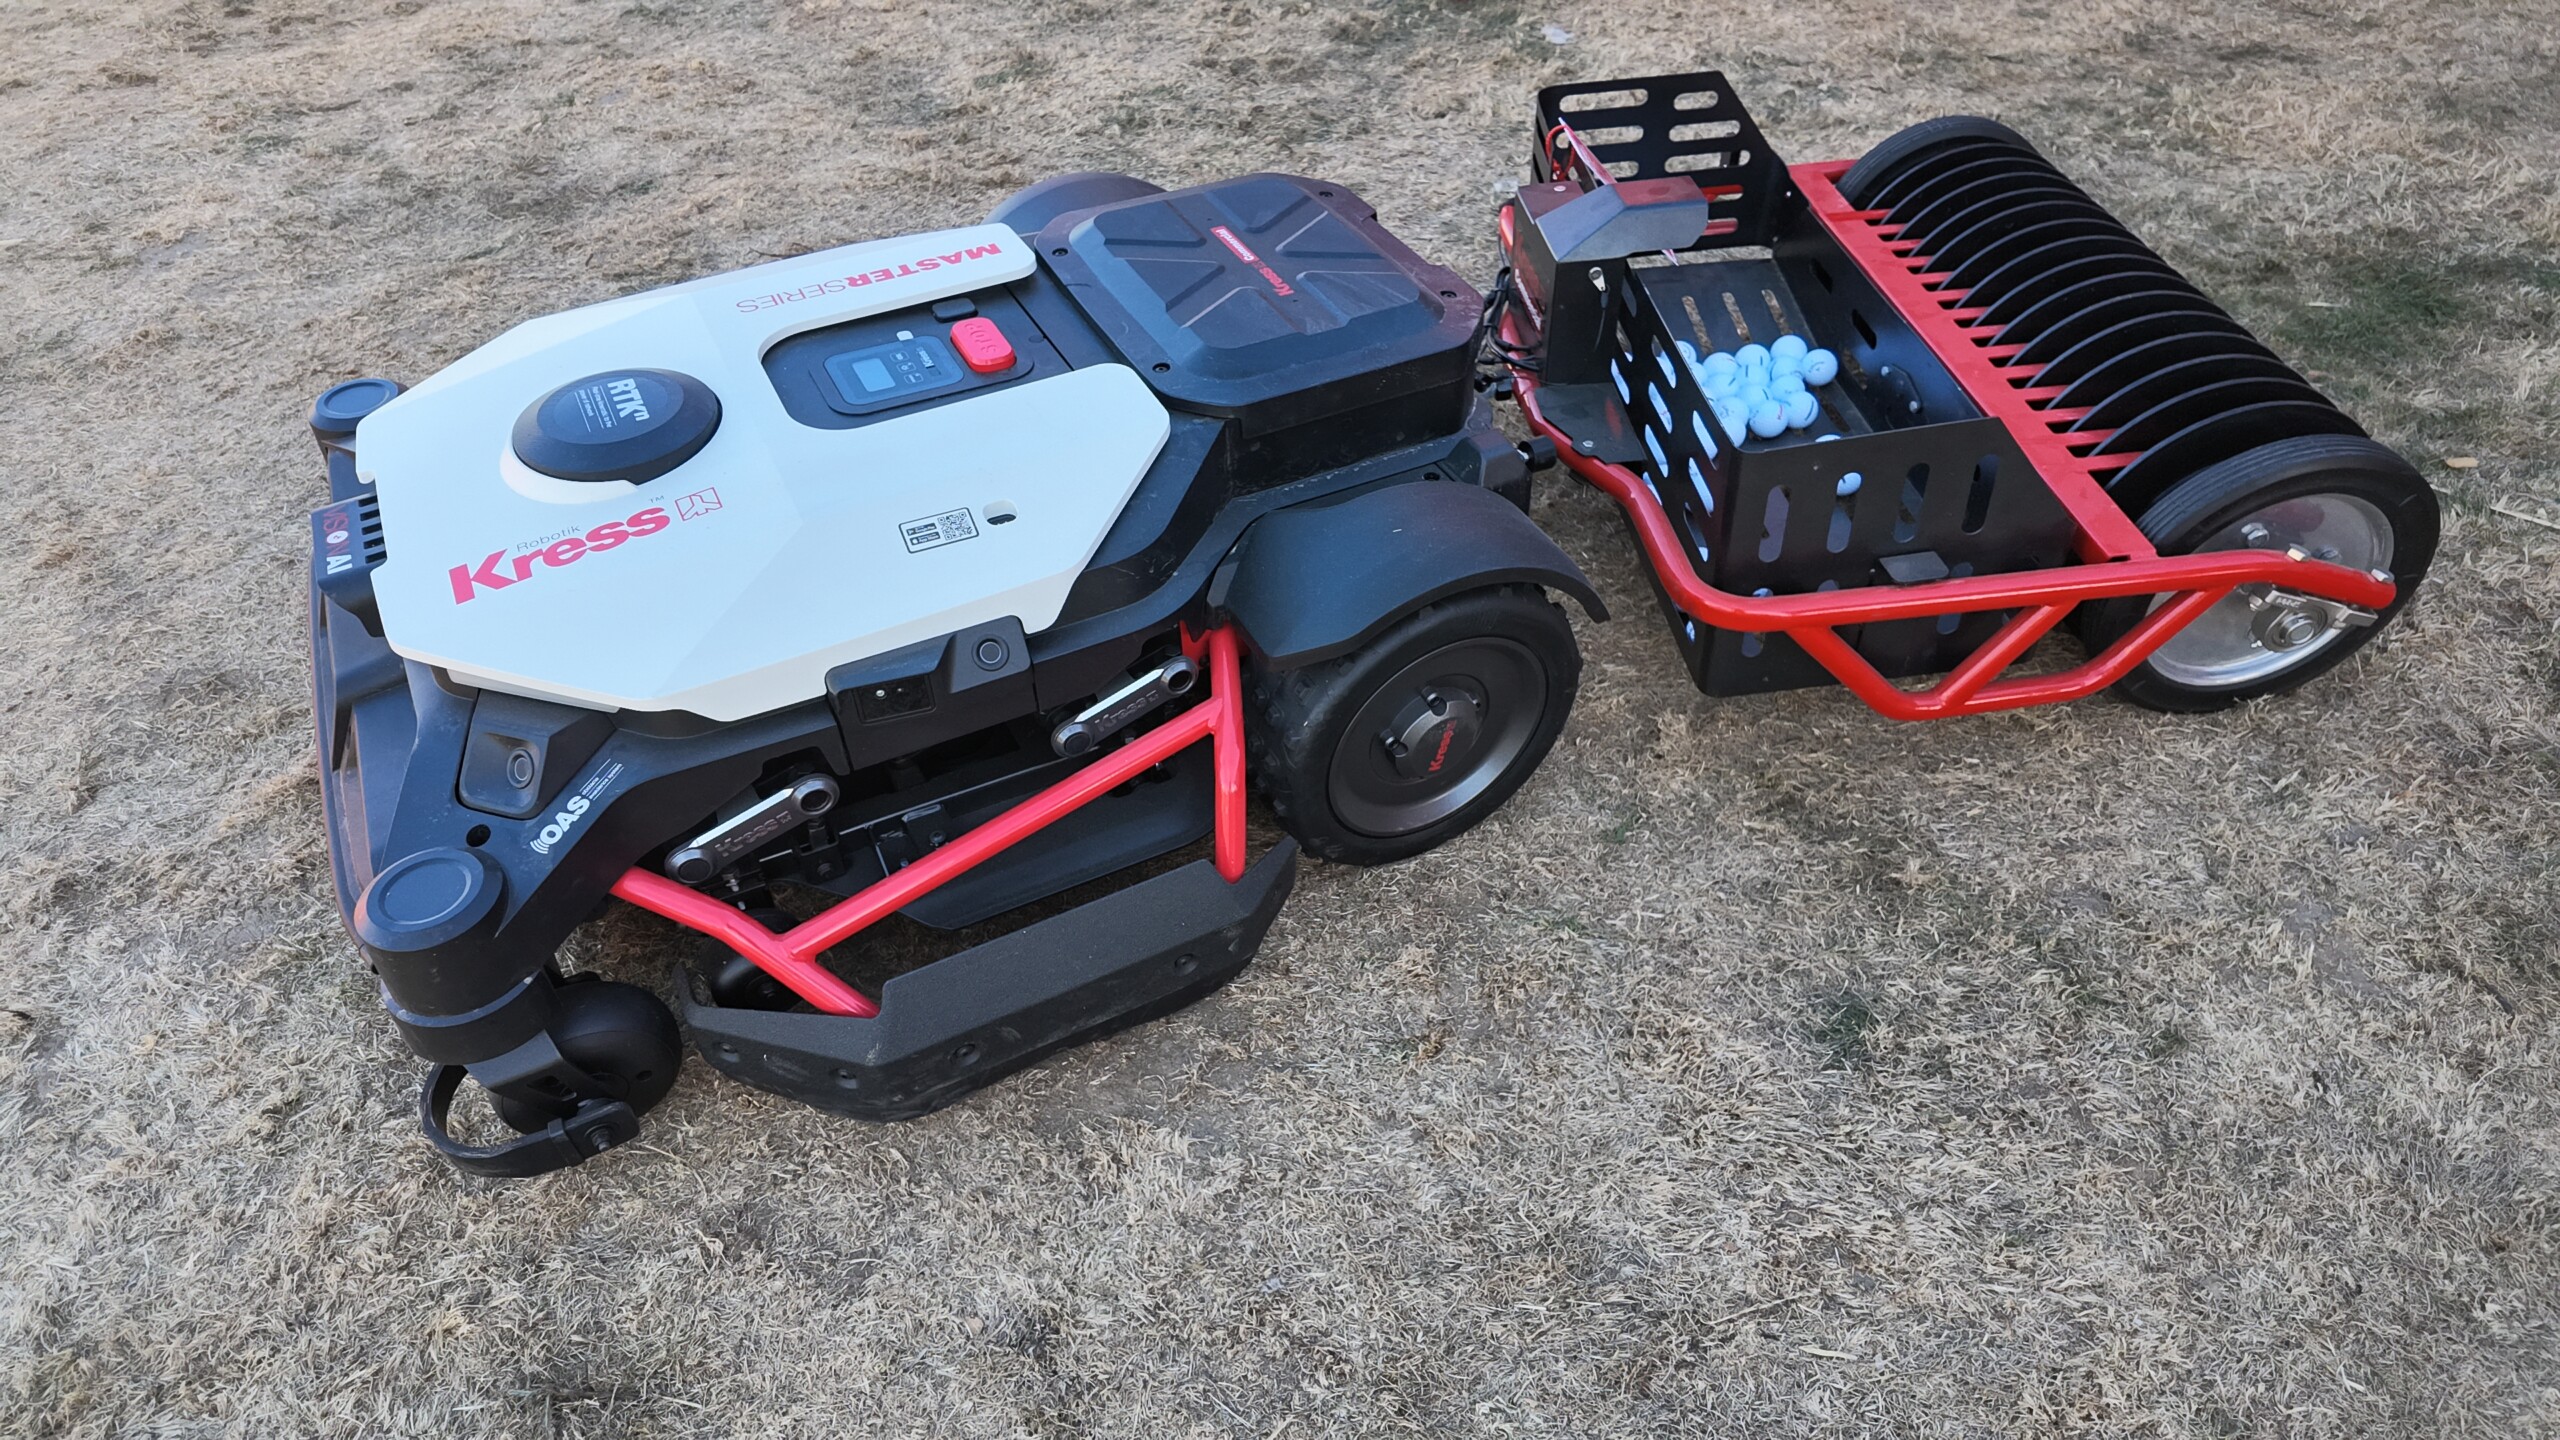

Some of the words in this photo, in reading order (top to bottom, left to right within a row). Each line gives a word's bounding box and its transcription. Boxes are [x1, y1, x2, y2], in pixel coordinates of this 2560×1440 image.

[1259, 267, 1295, 296] Kress
[964, 322, 998, 355] STOP
[448, 506, 671, 605] Kress
[516, 525, 581, 552] Robotik
[1095, 696, 1147, 733] Kress
[1428, 729, 1454, 772] Kress
[540, 795, 590, 845] OAS
[714, 818, 779, 858] Kress
